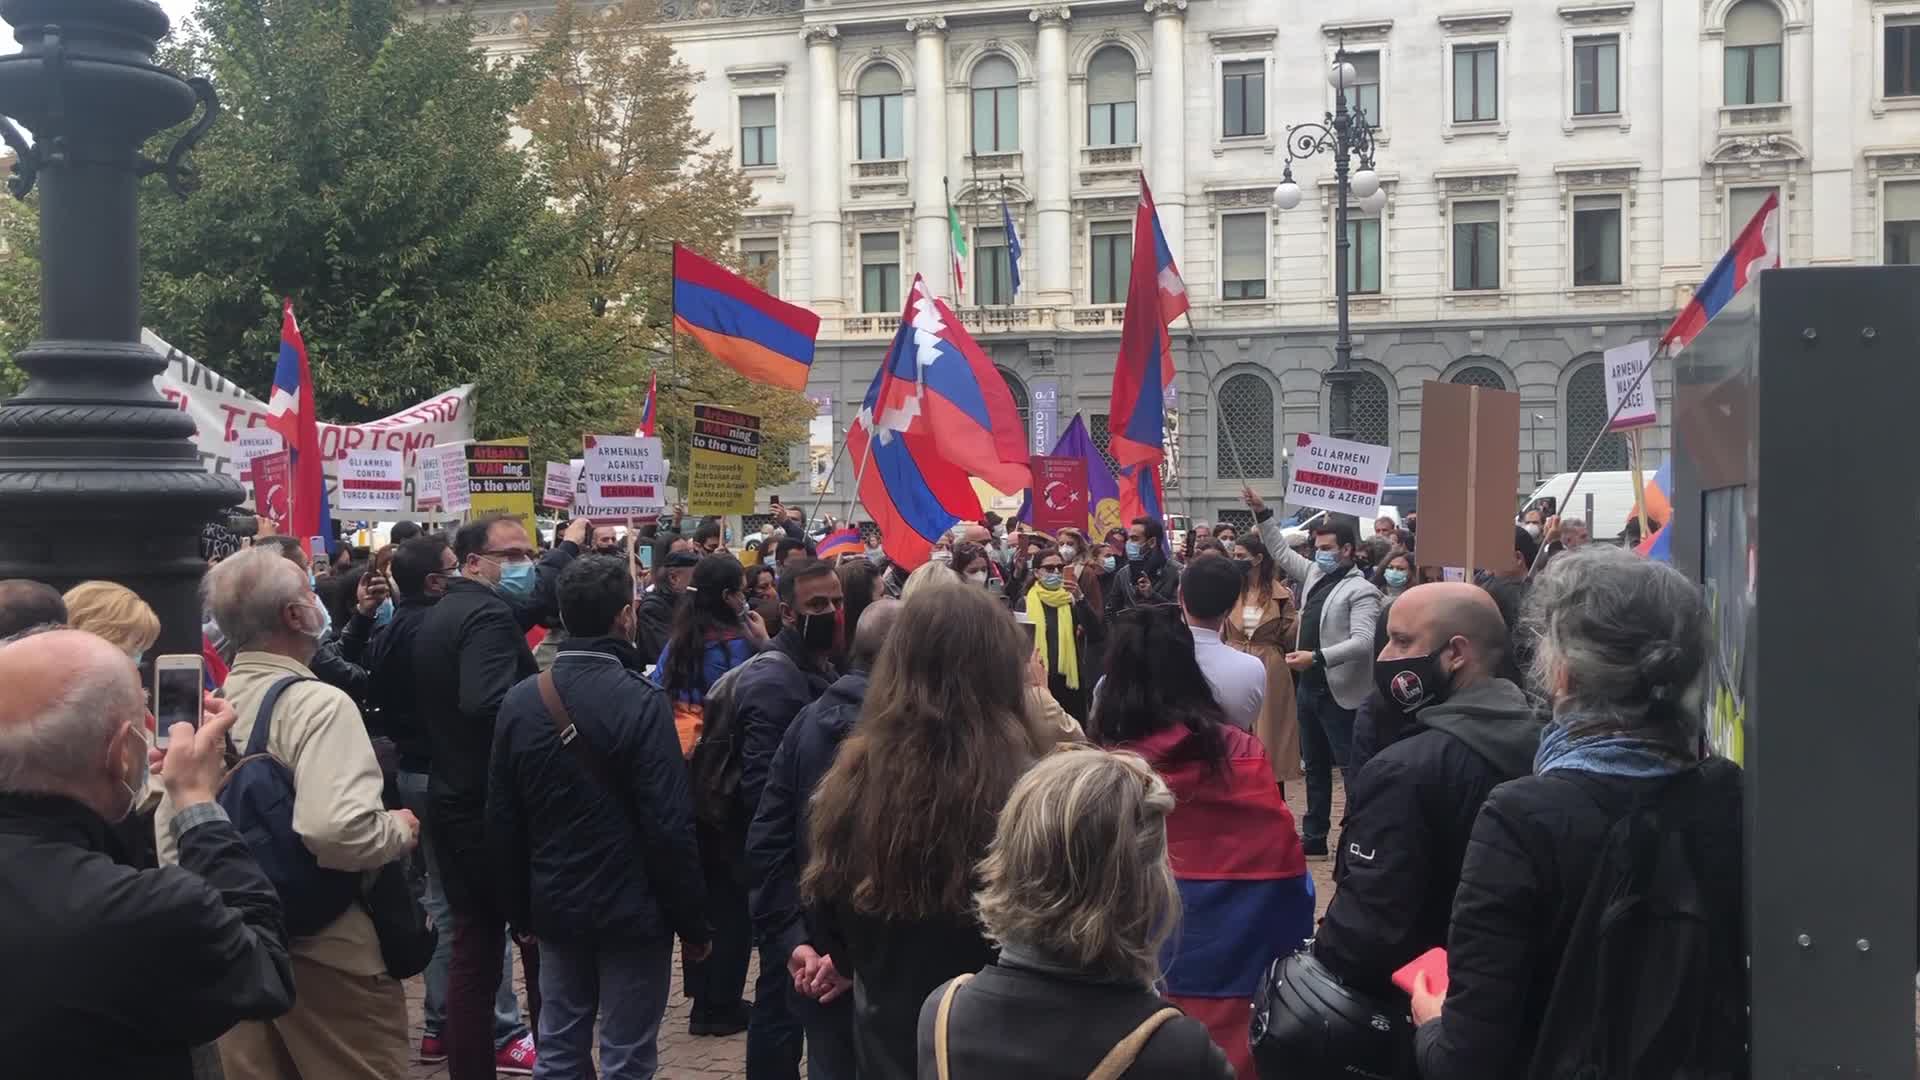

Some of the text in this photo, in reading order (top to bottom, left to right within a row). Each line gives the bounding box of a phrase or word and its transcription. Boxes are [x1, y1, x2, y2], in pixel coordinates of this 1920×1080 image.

[1612, 360, 1643, 378] ARMENIA
[598, 447, 650, 457] ARMENIANS
[694, 436, 757, 456] to the world
[1311, 446, 1371, 465] GLI ARMENI
[363, 459, 393, 468] ARMENI
[474, 462, 524, 477] WARning
[607, 461, 644, 470] AGAINST
[1317, 461, 1359, 476] CONTRO
[356, 470, 386, 478] CONTRO
[589, 473, 663, 483] TURKISH & AZERI
[470, 479, 531, 492] to the world
[1292, 483, 1326, 498] TURCO
[1327, 490, 1336, 500] &
[342, 491, 367, 500] TURCO
